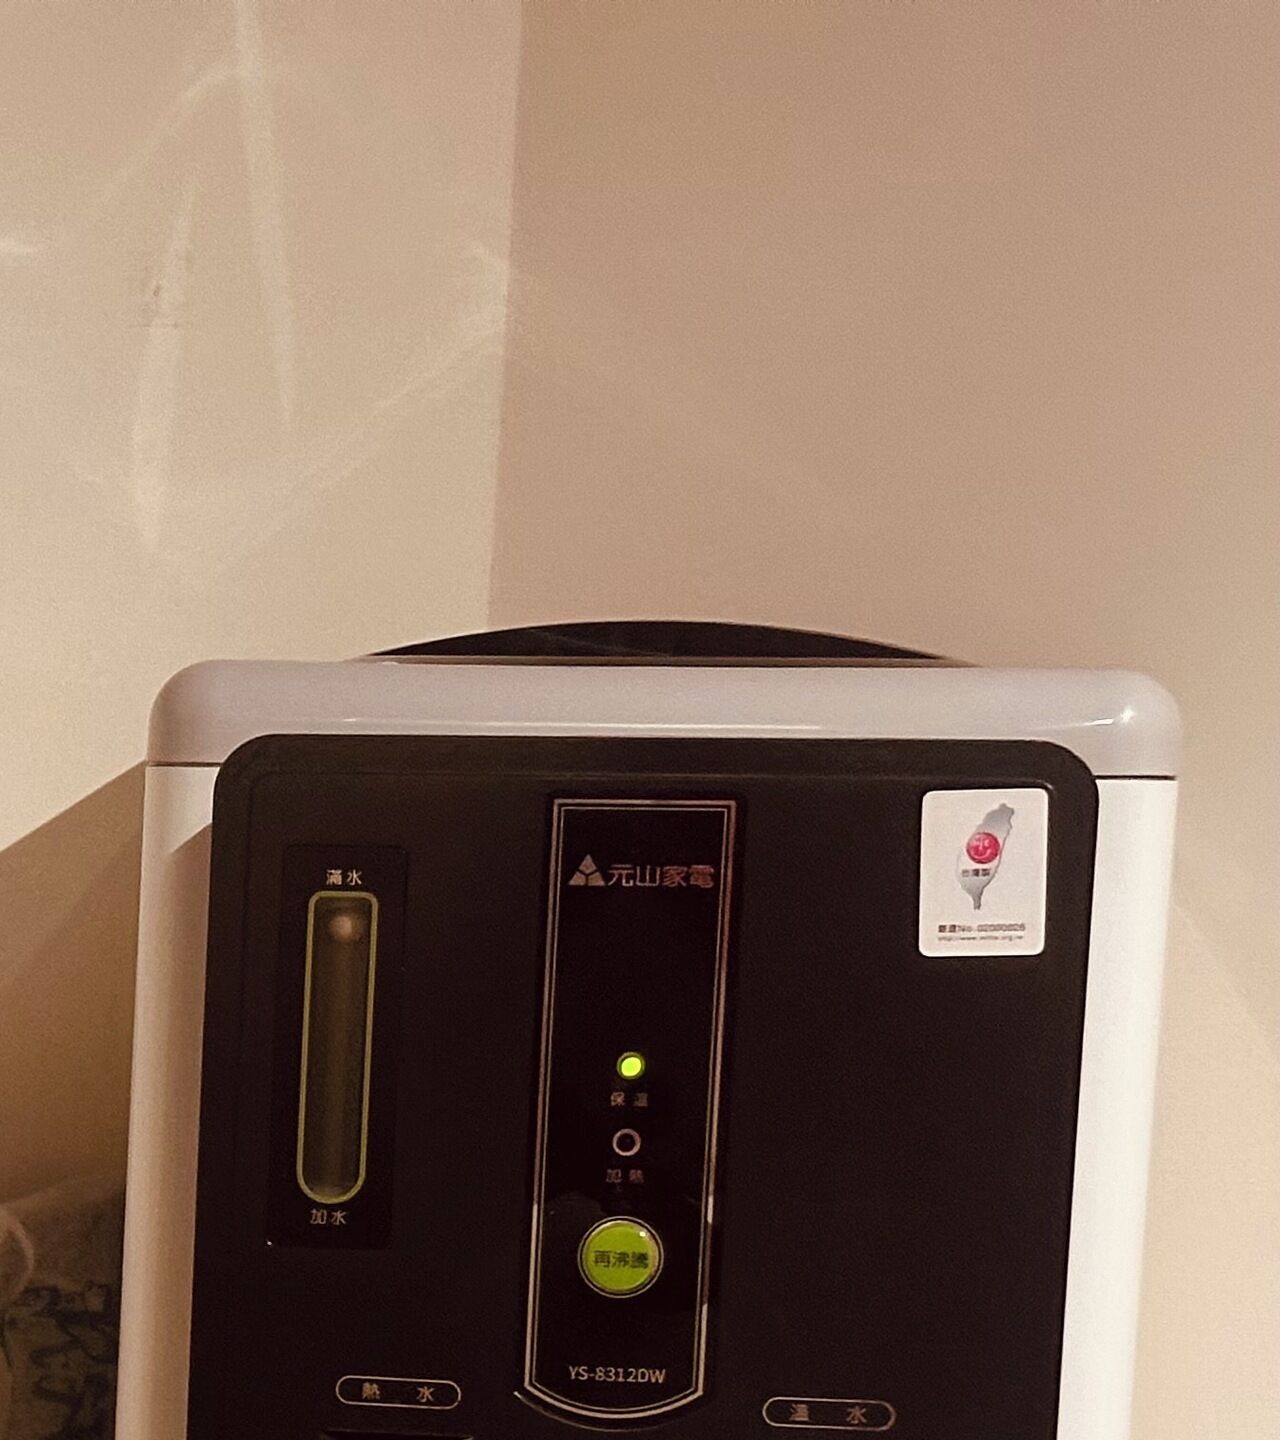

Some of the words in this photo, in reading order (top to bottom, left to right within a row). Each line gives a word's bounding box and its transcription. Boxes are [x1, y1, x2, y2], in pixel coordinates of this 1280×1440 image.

[326, 869, 362, 886] 滿水
[608, 864, 715, 888] 元山家電
[309, 1208, 347, 1226] 加水
[594, 1250, 649, 1269] 再沸騰
[568, 1365, 666, 1384] YS-8312DW
